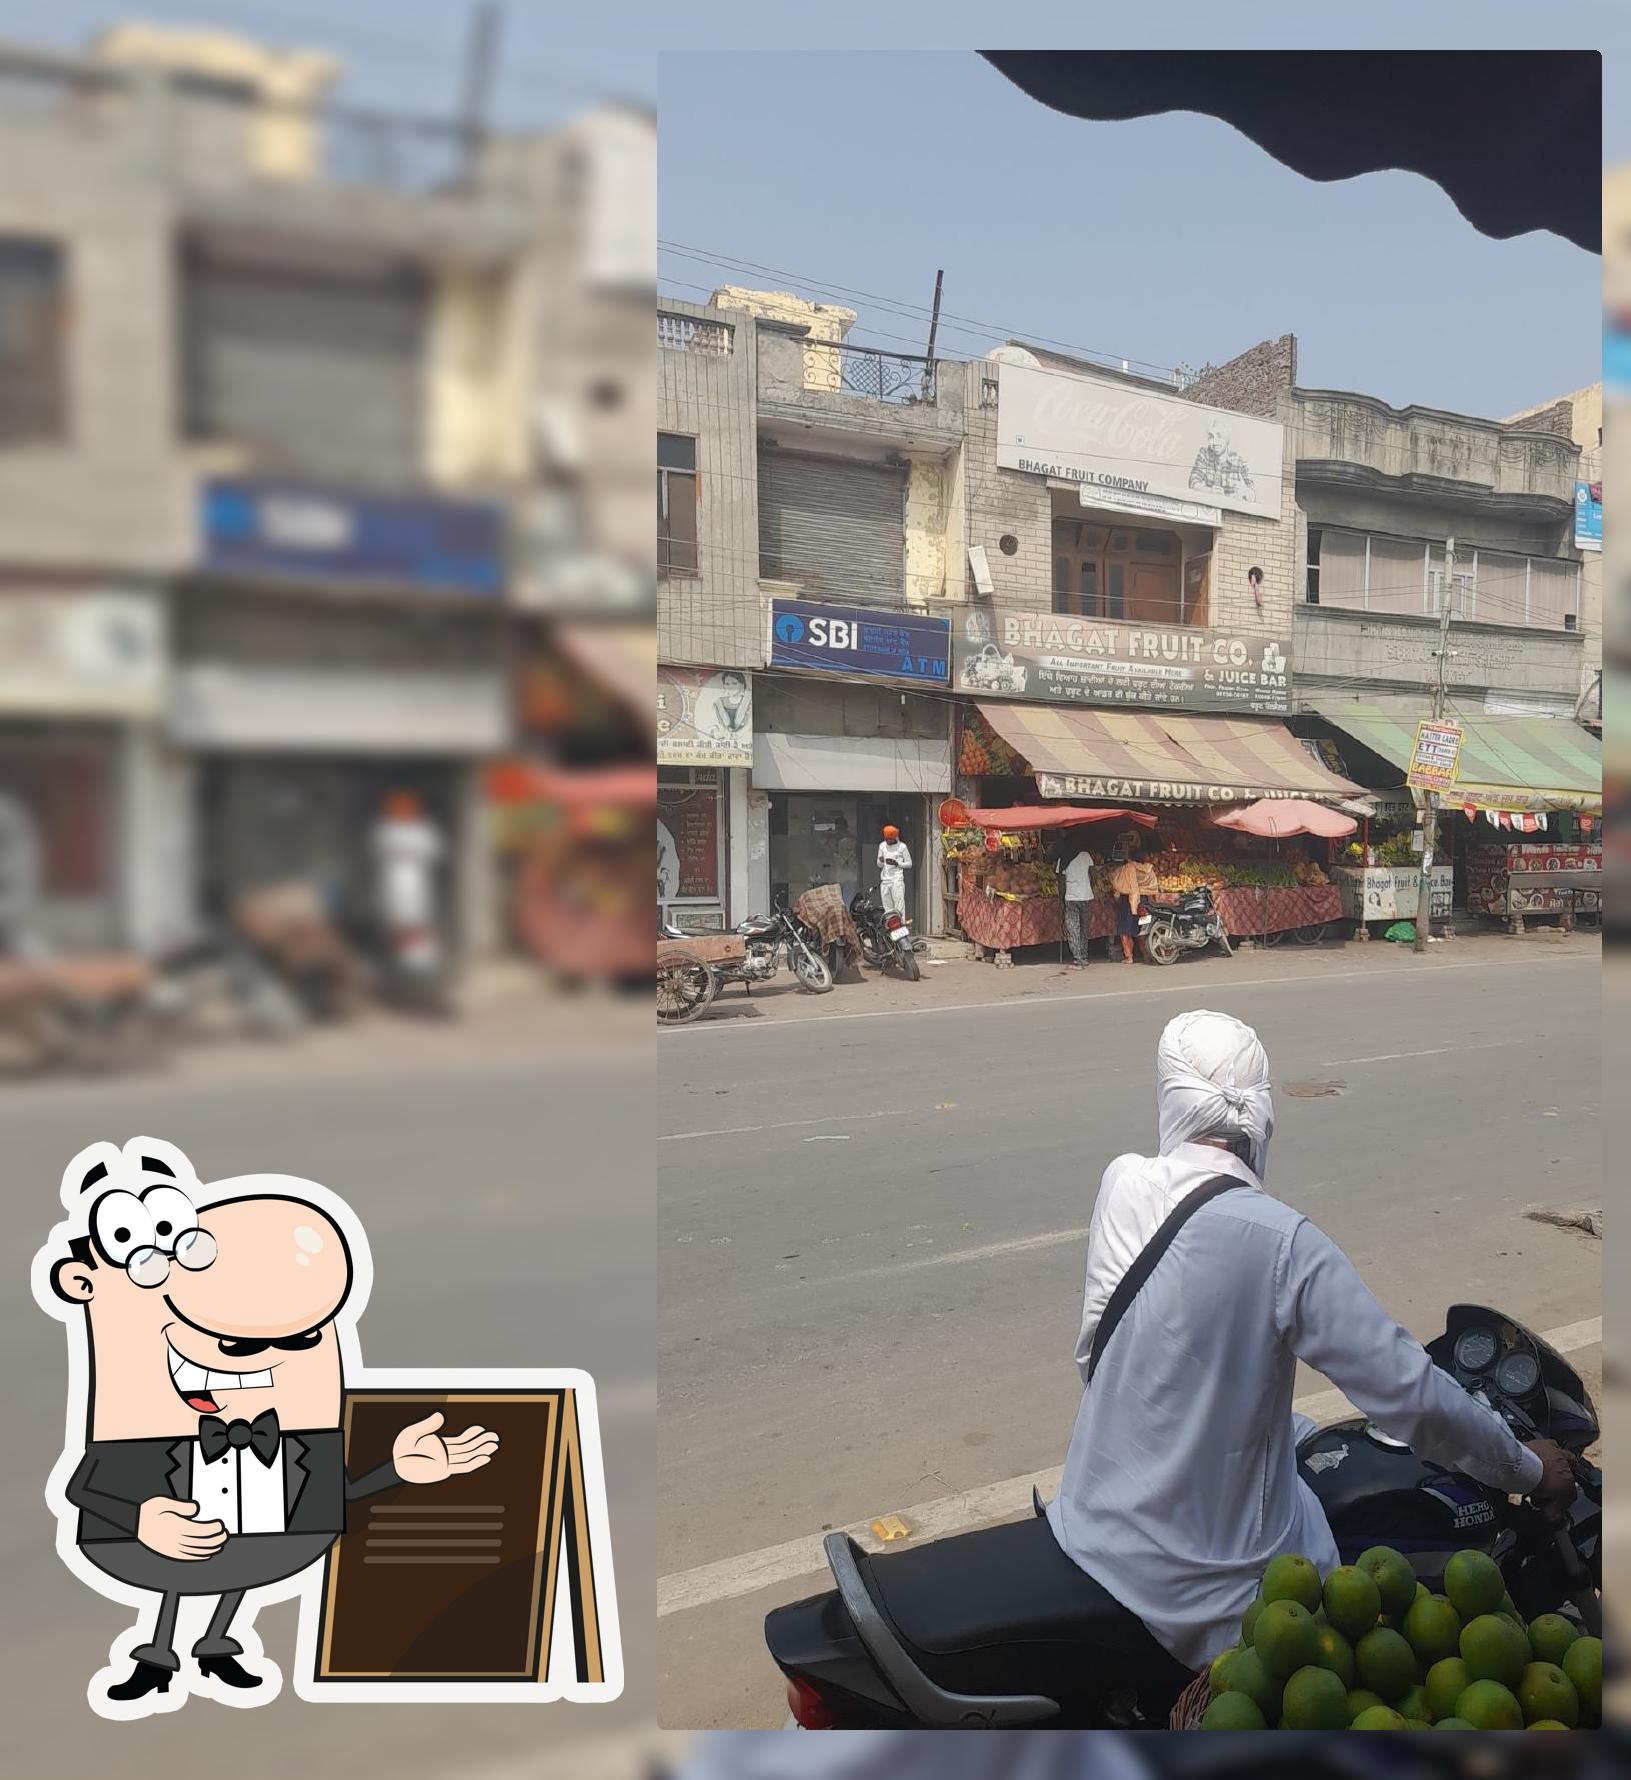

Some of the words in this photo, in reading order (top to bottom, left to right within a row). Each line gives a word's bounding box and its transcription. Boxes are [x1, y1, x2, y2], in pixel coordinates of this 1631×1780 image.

[1018, 458, 1062, 477] BHAGAT
[1065, 467, 1095, 482] FRUIT
[1098, 473, 1149, 492] COMPANY
[808, 618, 858, 650] SBI
[1004, 617, 1119, 655] BHAGAT
[1128, 631, 1204, 662] FRUIT
[1213, 638, 1253, 666] CO.
[1203, 669, 1214, 681] &
[1218, 670, 1257, 684] JUICE
[1260, 673, 1287, 687] BAR
[1418, 742, 1437, 754] ETT
[1065, 776, 1144, 797] BHAGAT
[1148, 781, 1202, 799] FRUIT
[1367, 875, 1391, 892] Bhagat
[1394, 875, 1411, 889] Fruit
[1457, 1500, 1490, 1517] HERO
[1453, 1510, 1495, 1529] HONDA
